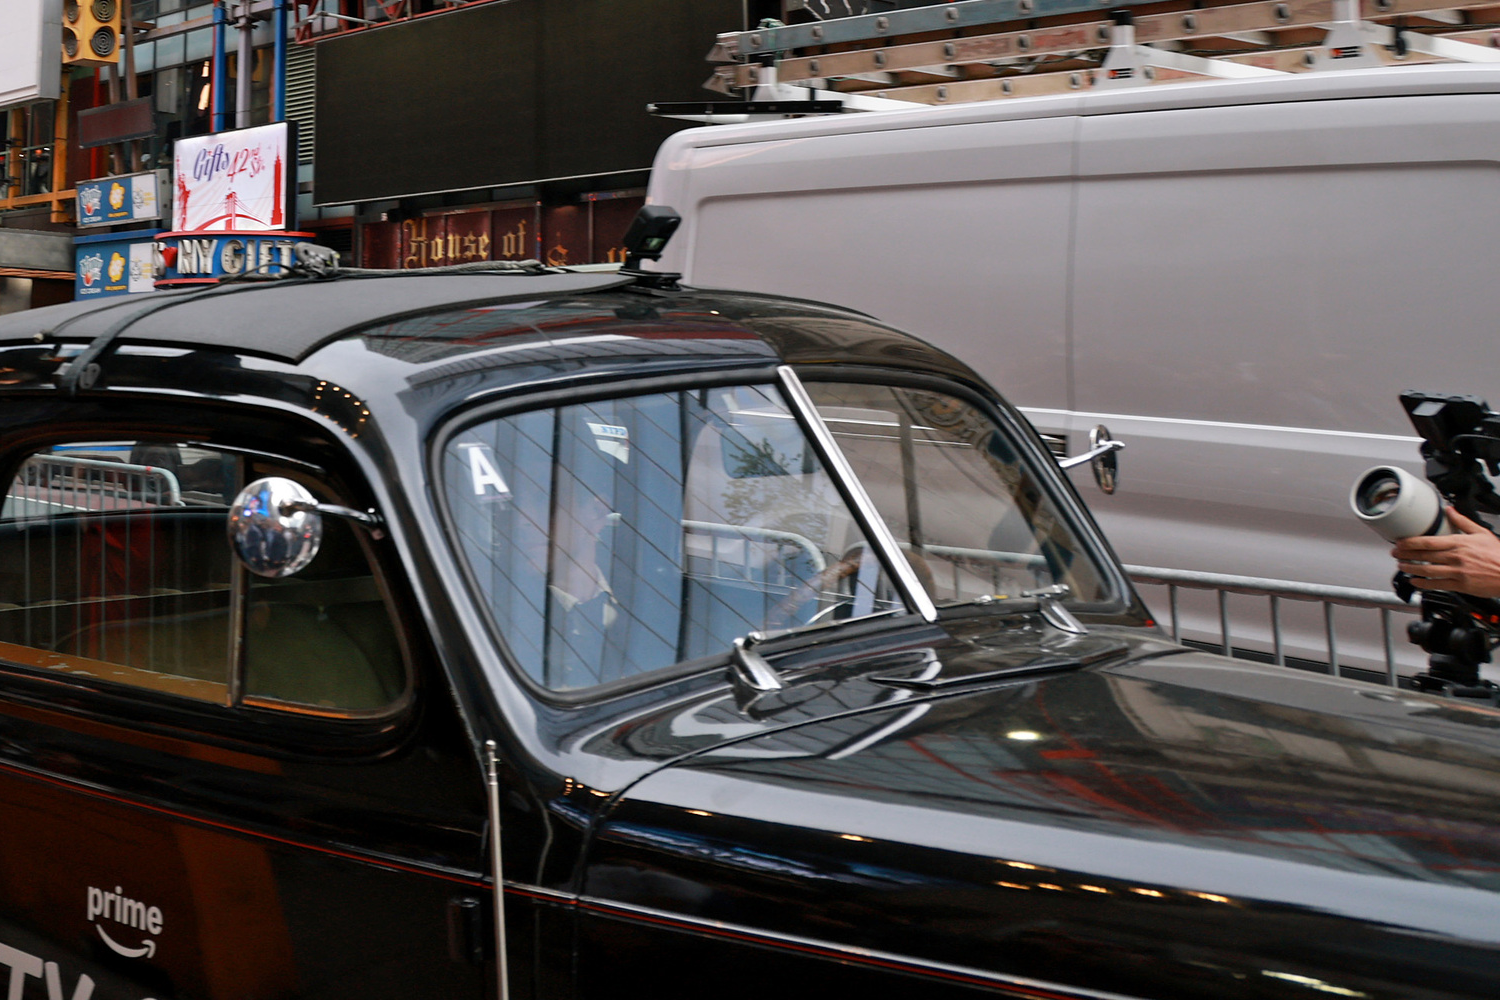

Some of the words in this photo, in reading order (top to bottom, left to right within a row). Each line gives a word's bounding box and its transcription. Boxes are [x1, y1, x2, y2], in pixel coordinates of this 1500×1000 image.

[194, 144, 229, 181] Gifts
[502, 218, 527, 258] of
[221, 239, 295, 276] GIFT
[87, 885, 163, 935] prime
